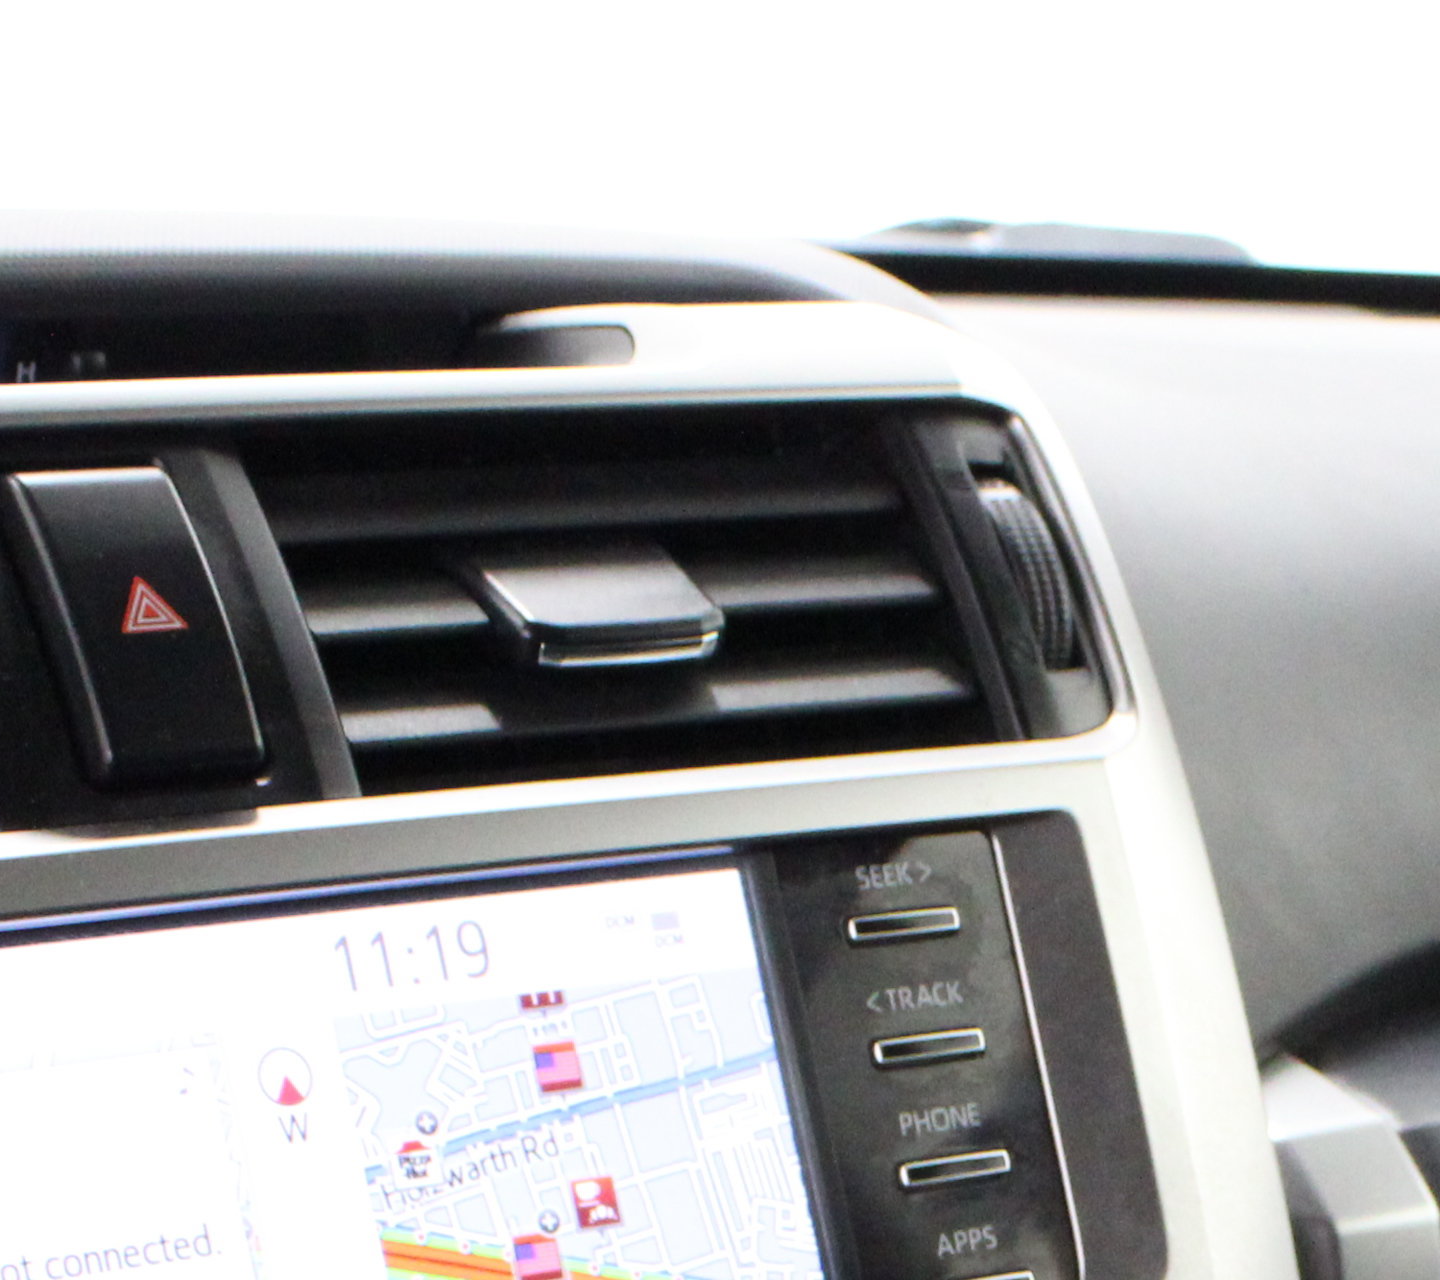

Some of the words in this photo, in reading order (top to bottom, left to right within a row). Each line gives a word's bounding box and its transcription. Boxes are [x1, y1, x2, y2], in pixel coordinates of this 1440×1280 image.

[855, 861, 914, 892] SEEK
[334, 920, 490, 992] 11:19
[885, 981, 964, 1012] TRACK
[899, 1102, 983, 1137] PHONE
[520, 1130, 560, 1163] Rd
[937, 1224, 999, 1258] APPS
